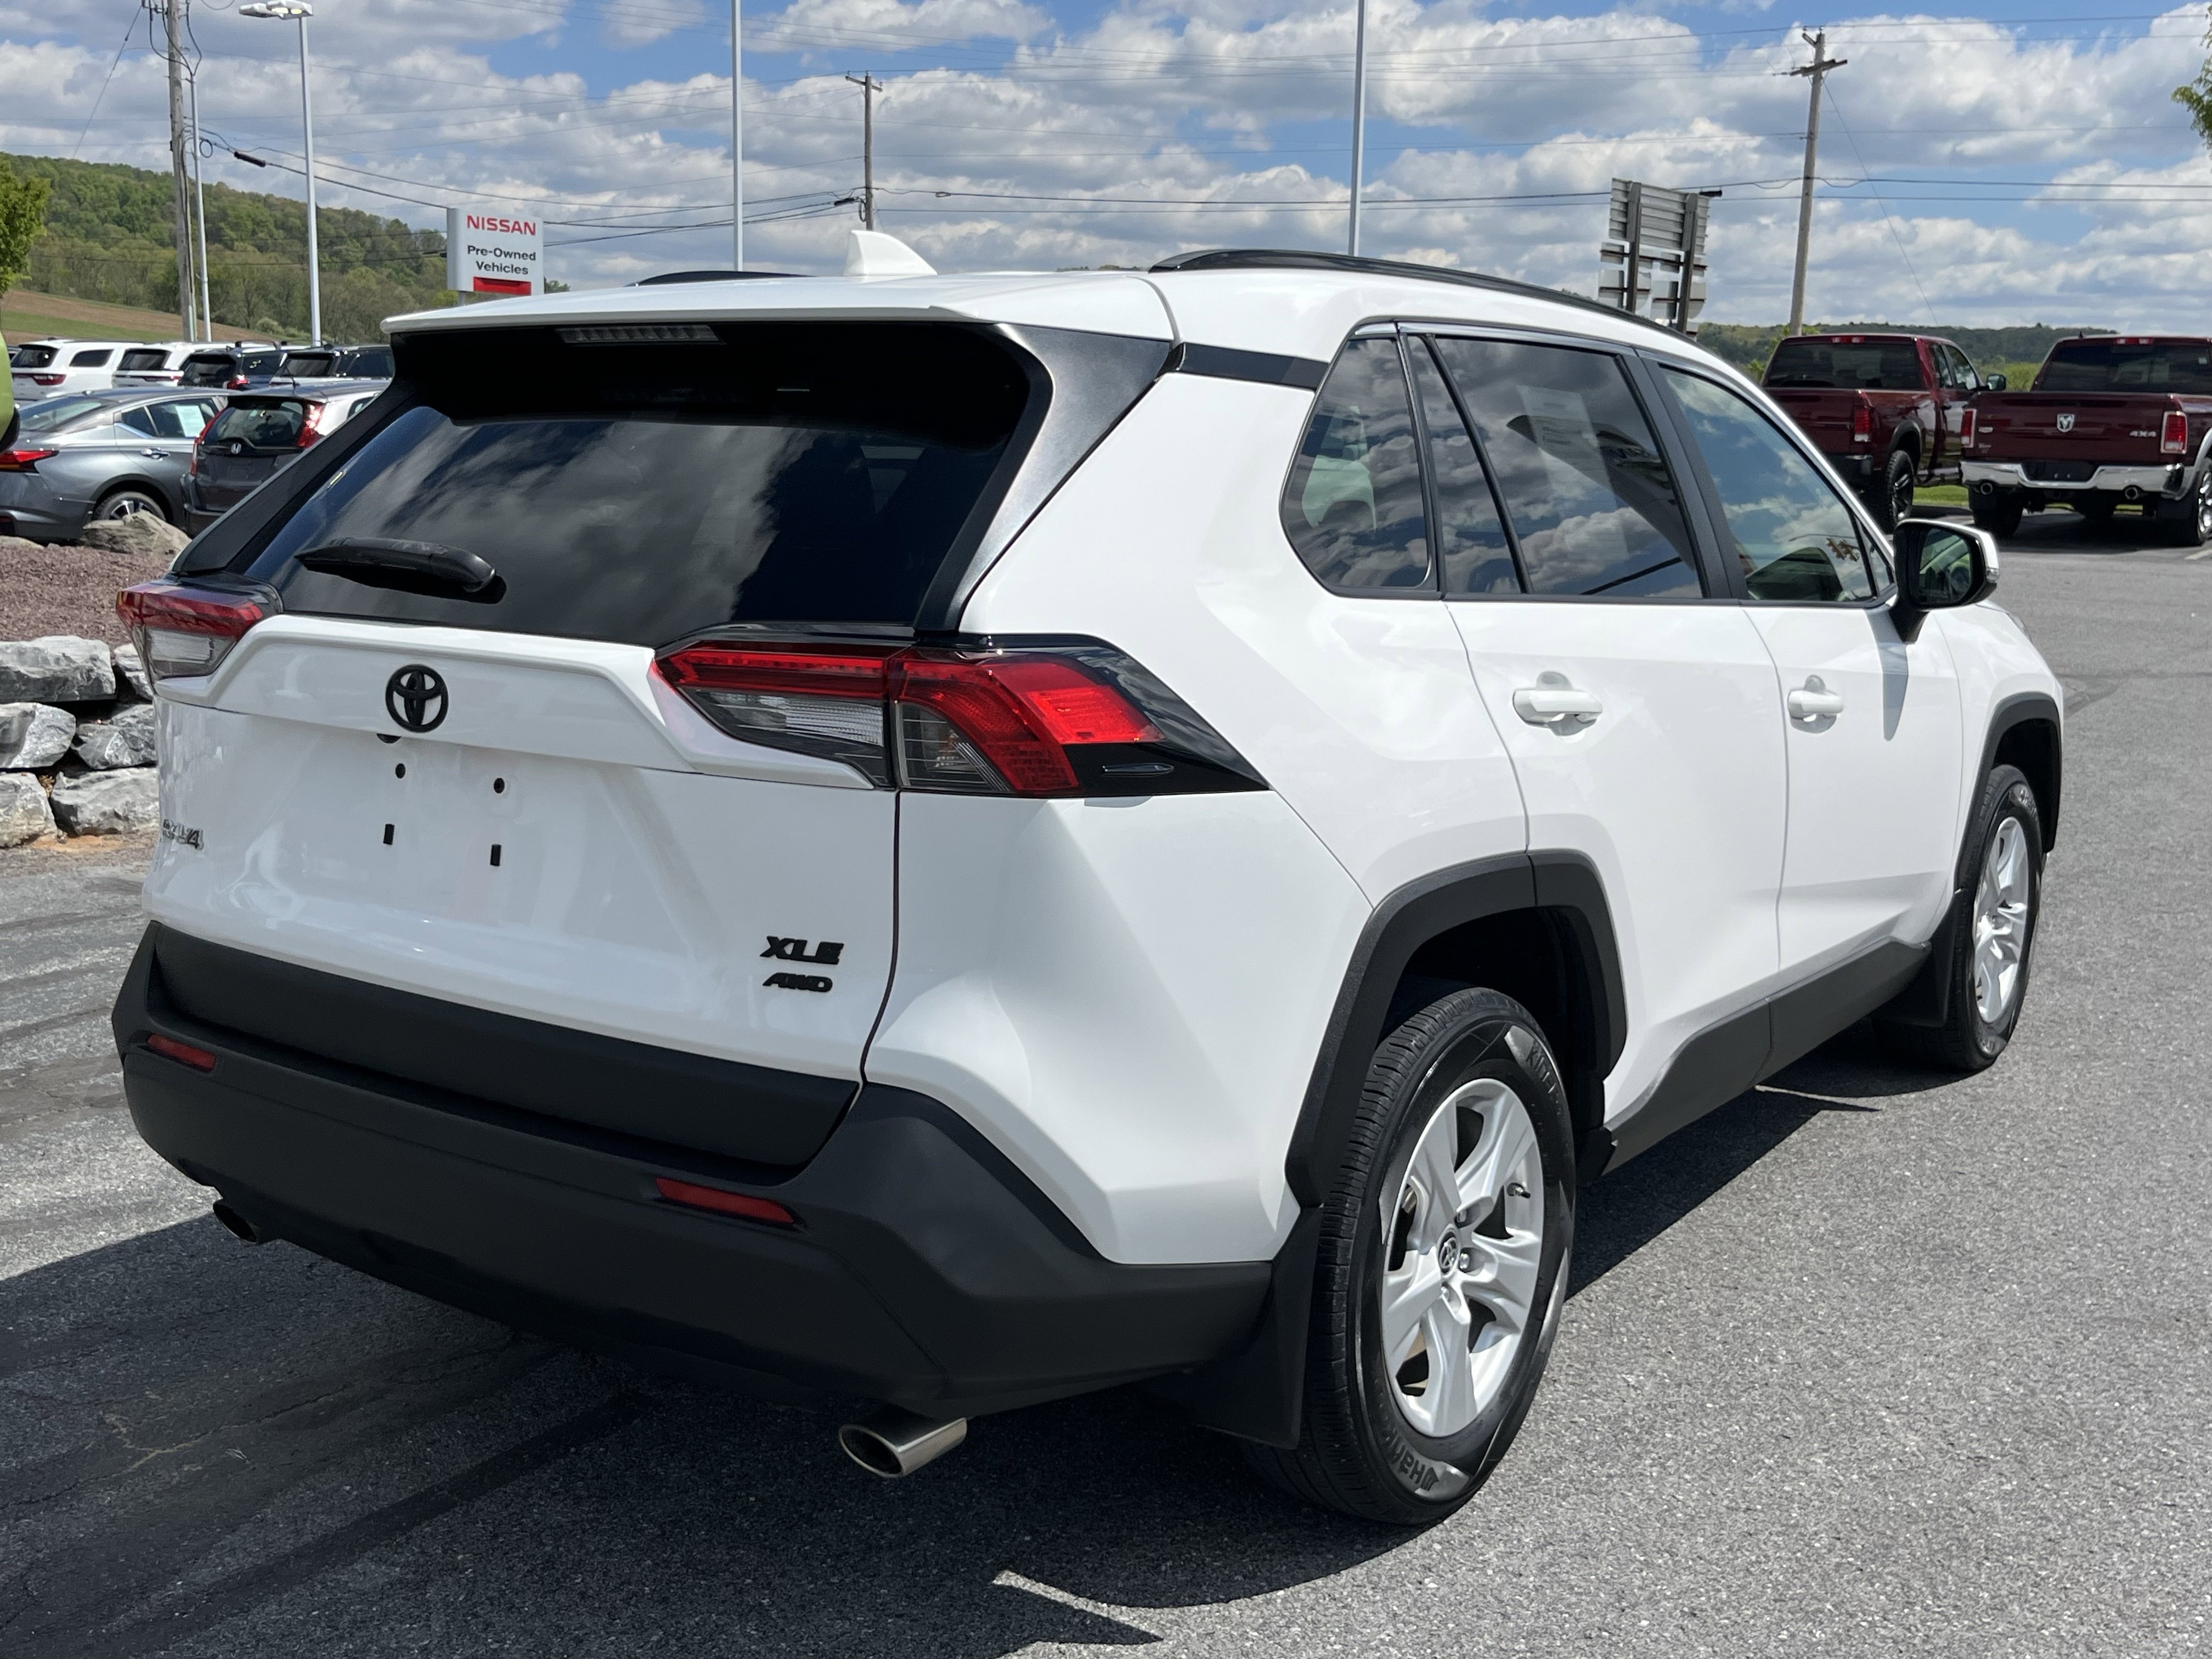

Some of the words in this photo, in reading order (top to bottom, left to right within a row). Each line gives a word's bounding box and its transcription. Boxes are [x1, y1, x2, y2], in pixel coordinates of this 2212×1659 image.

[467, 215, 537, 236] NISSAN
[467, 245, 537, 261] Pre-Owned
[476, 261, 529, 275] Vehicles
[759, 935, 845, 966] XLE
